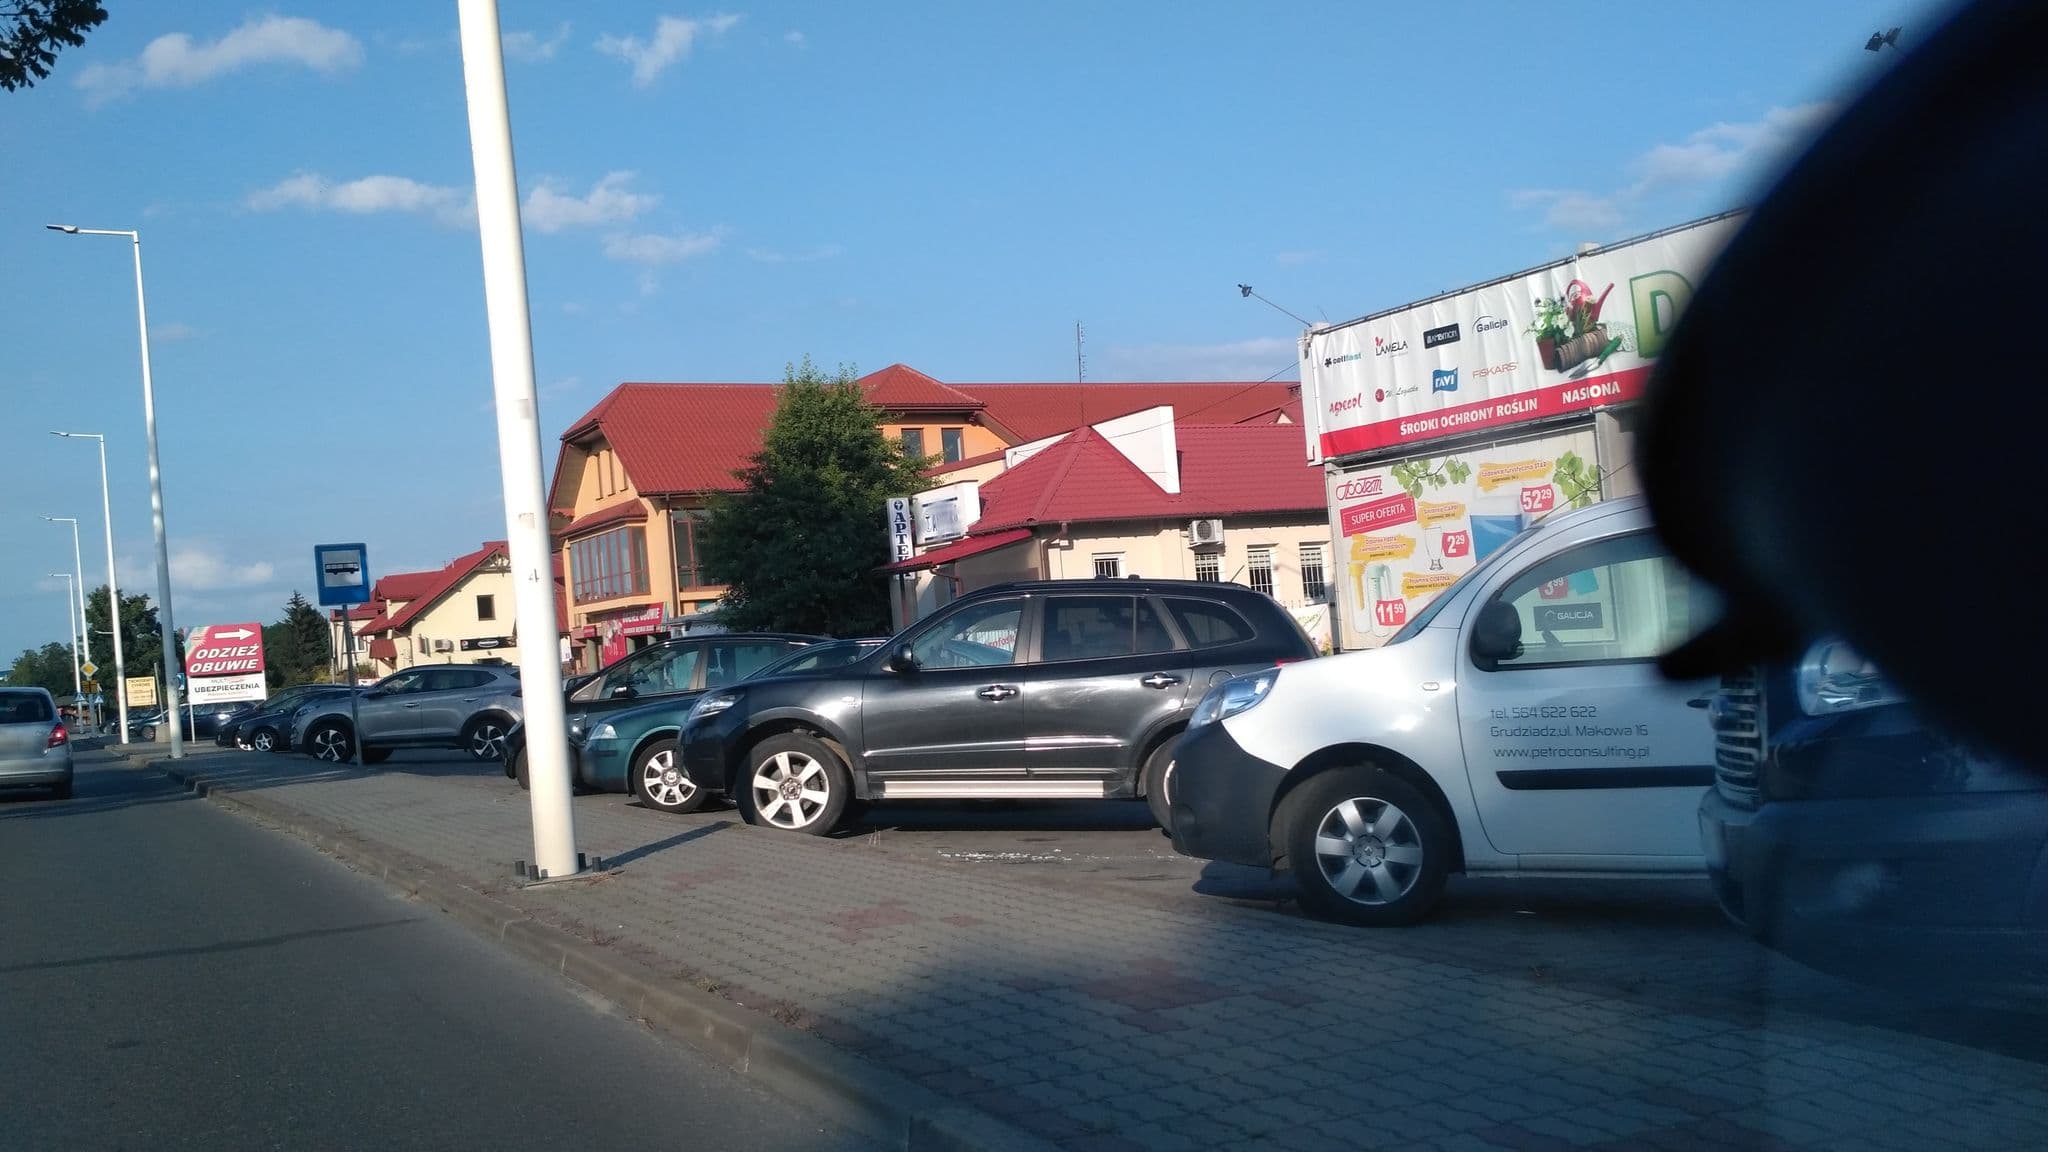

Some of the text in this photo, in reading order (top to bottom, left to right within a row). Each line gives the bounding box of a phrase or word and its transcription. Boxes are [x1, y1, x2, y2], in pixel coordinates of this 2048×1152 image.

[1476, 319, 1508, 332] Galicja
[1376, 341, 1408, 356] LAMELA
[1562, 381, 1621, 405] NASIONA
[1400, 398, 1538, 436] ŚRODKI OCHRONY ROŚLIN
[1351, 509, 1375, 525] SUPER
[1375, 503, 1406, 519] OFERTA
[893, 511, 913, 577] APTE
[1557, 610, 1594, 620] GALICJA
[195, 643, 260, 659] ODZIEŻ
[189, 659, 259, 673] OBUWIE
[194, 683, 260, 693] UBEZPIECZENIA
[1540, 706, 1567, 718] 622
[1569, 705, 1597, 718] 622
[1575, 724, 1632, 737] Makowa
[1634, 723, 1649, 736] 16
[1493, 746, 1650, 760] www.petroconsulting.pl
